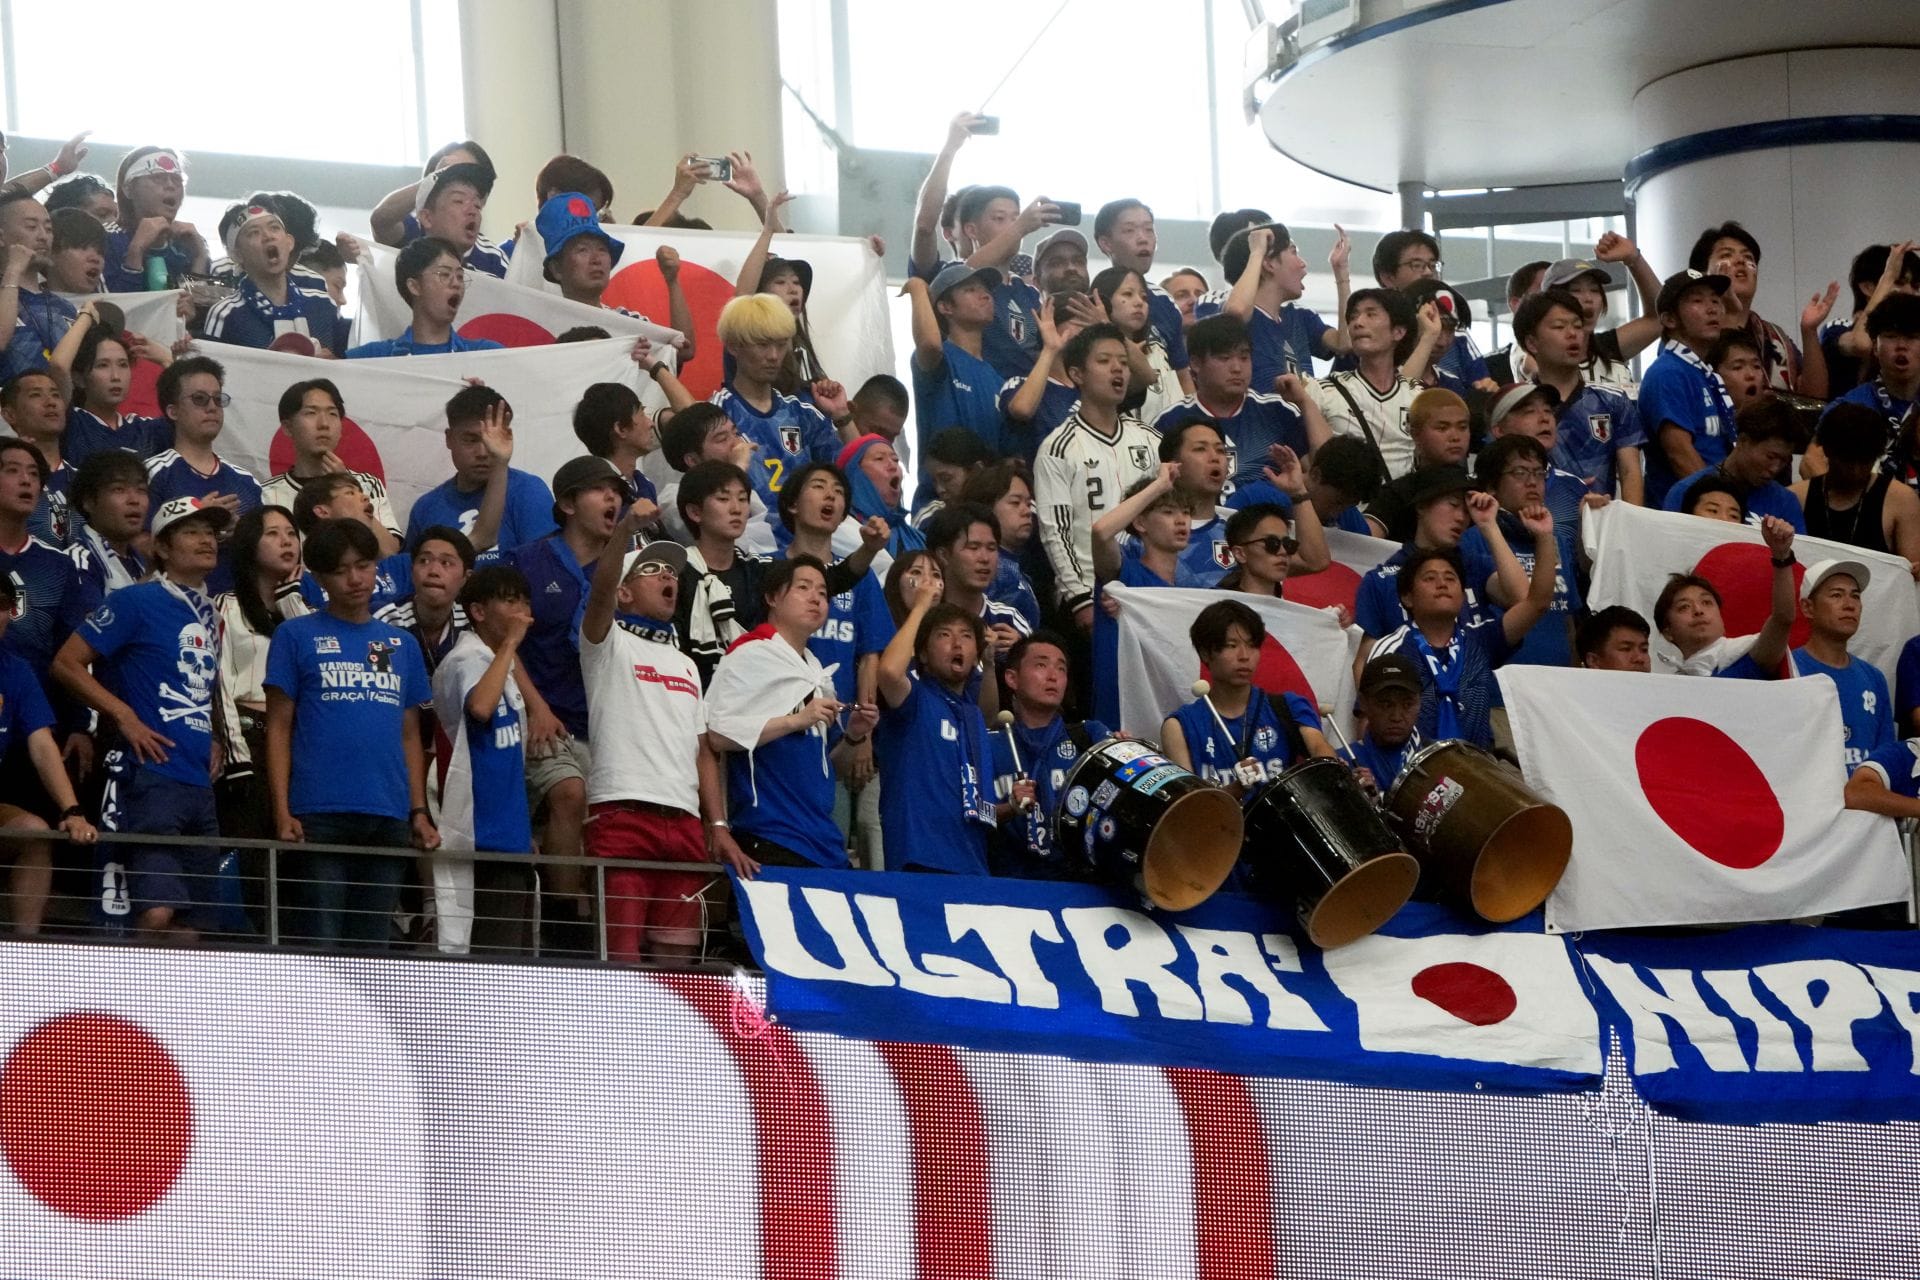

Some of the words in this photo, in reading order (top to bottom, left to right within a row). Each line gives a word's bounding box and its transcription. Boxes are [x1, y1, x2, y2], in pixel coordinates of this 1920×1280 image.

[763, 458, 782, 492] 2
[1086, 477, 1105, 510] 2
[319, 661, 365, 672] VAMOS!
[321, 670, 401, 692] NIPPON
[321, 691, 365, 703] GRAÇA
